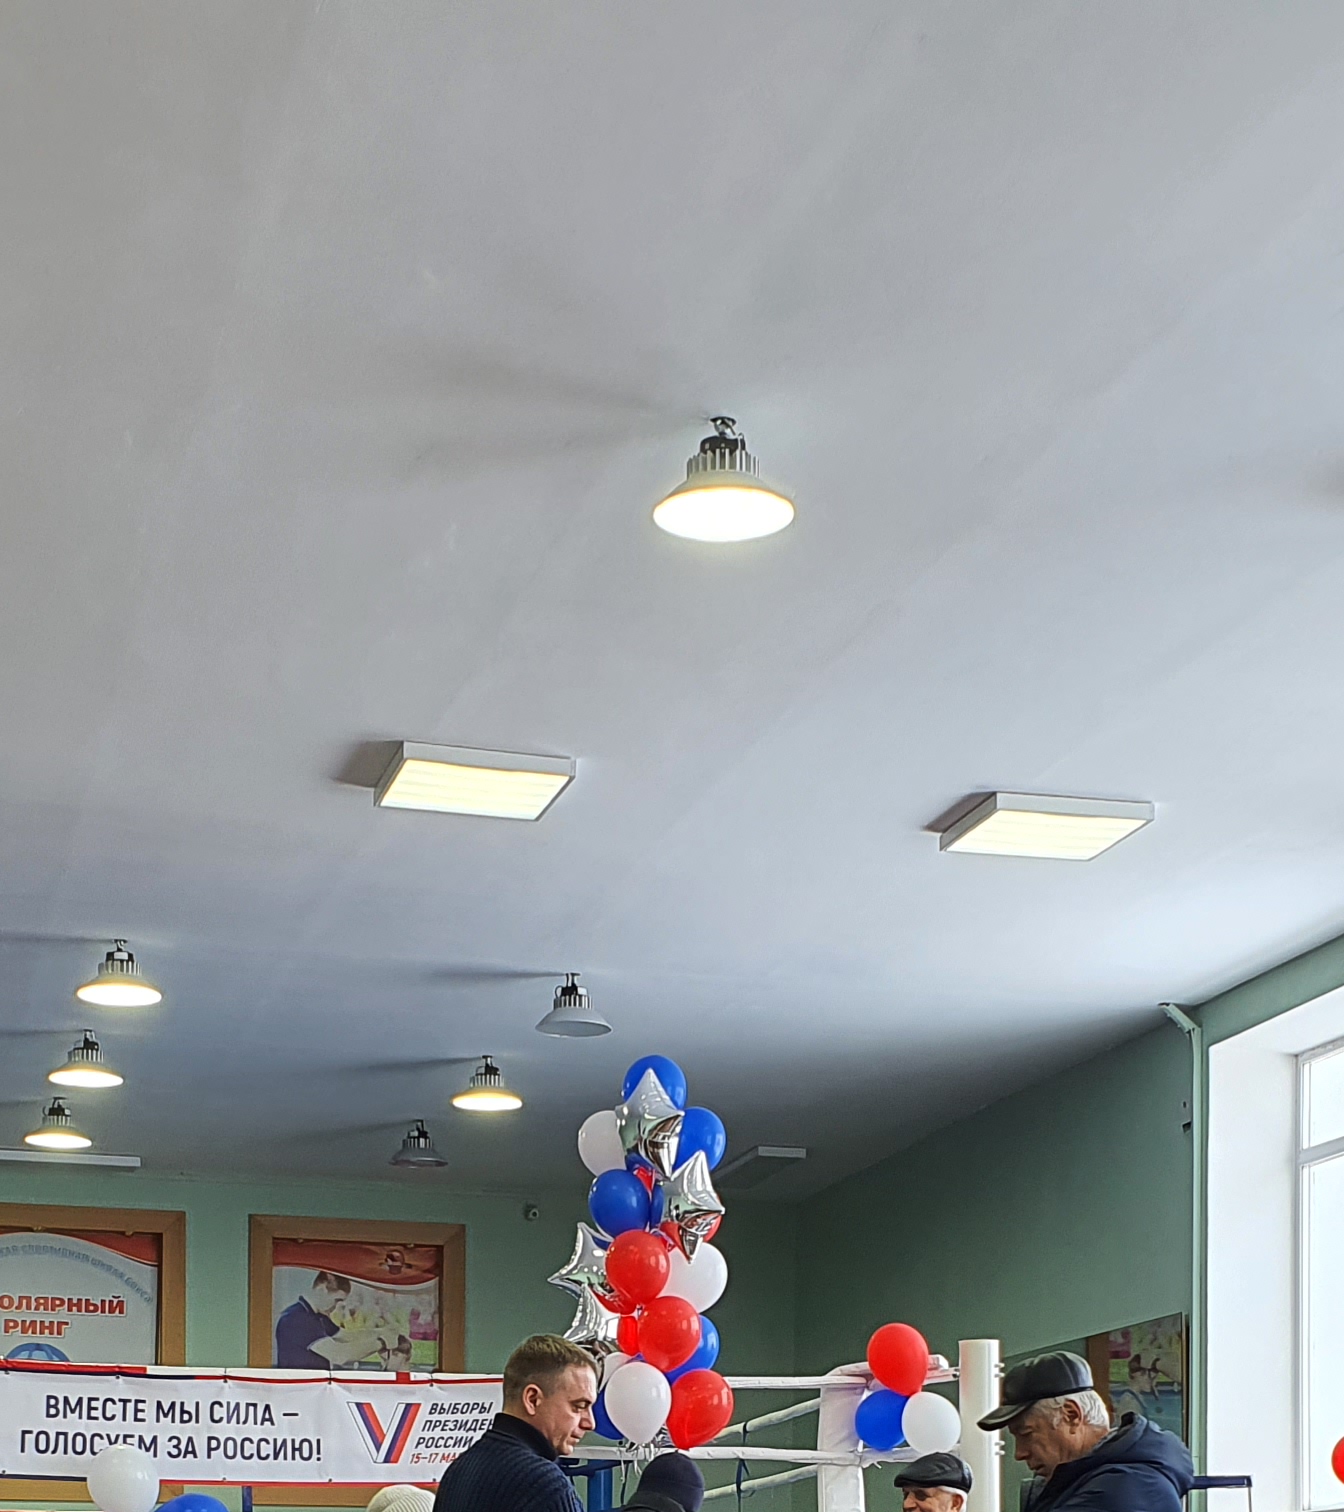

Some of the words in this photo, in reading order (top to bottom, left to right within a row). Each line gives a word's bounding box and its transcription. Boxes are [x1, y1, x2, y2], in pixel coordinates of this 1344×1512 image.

[3, 1318, 70, 1336] РИНГ
[45, 1394, 147, 1423] ВМЕСТЕ
[155, 1399, 200, 1425] МЫ
[209, 1400, 276, 1426] СИЛА
[428, 1402, 494, 1415] ВЫБОРЫ
[166, 1435, 199, 1460] ЗА
[206, 1436, 323, 1462] РОССИЮ!
[415, 1436, 474, 1450] РОССИИ
